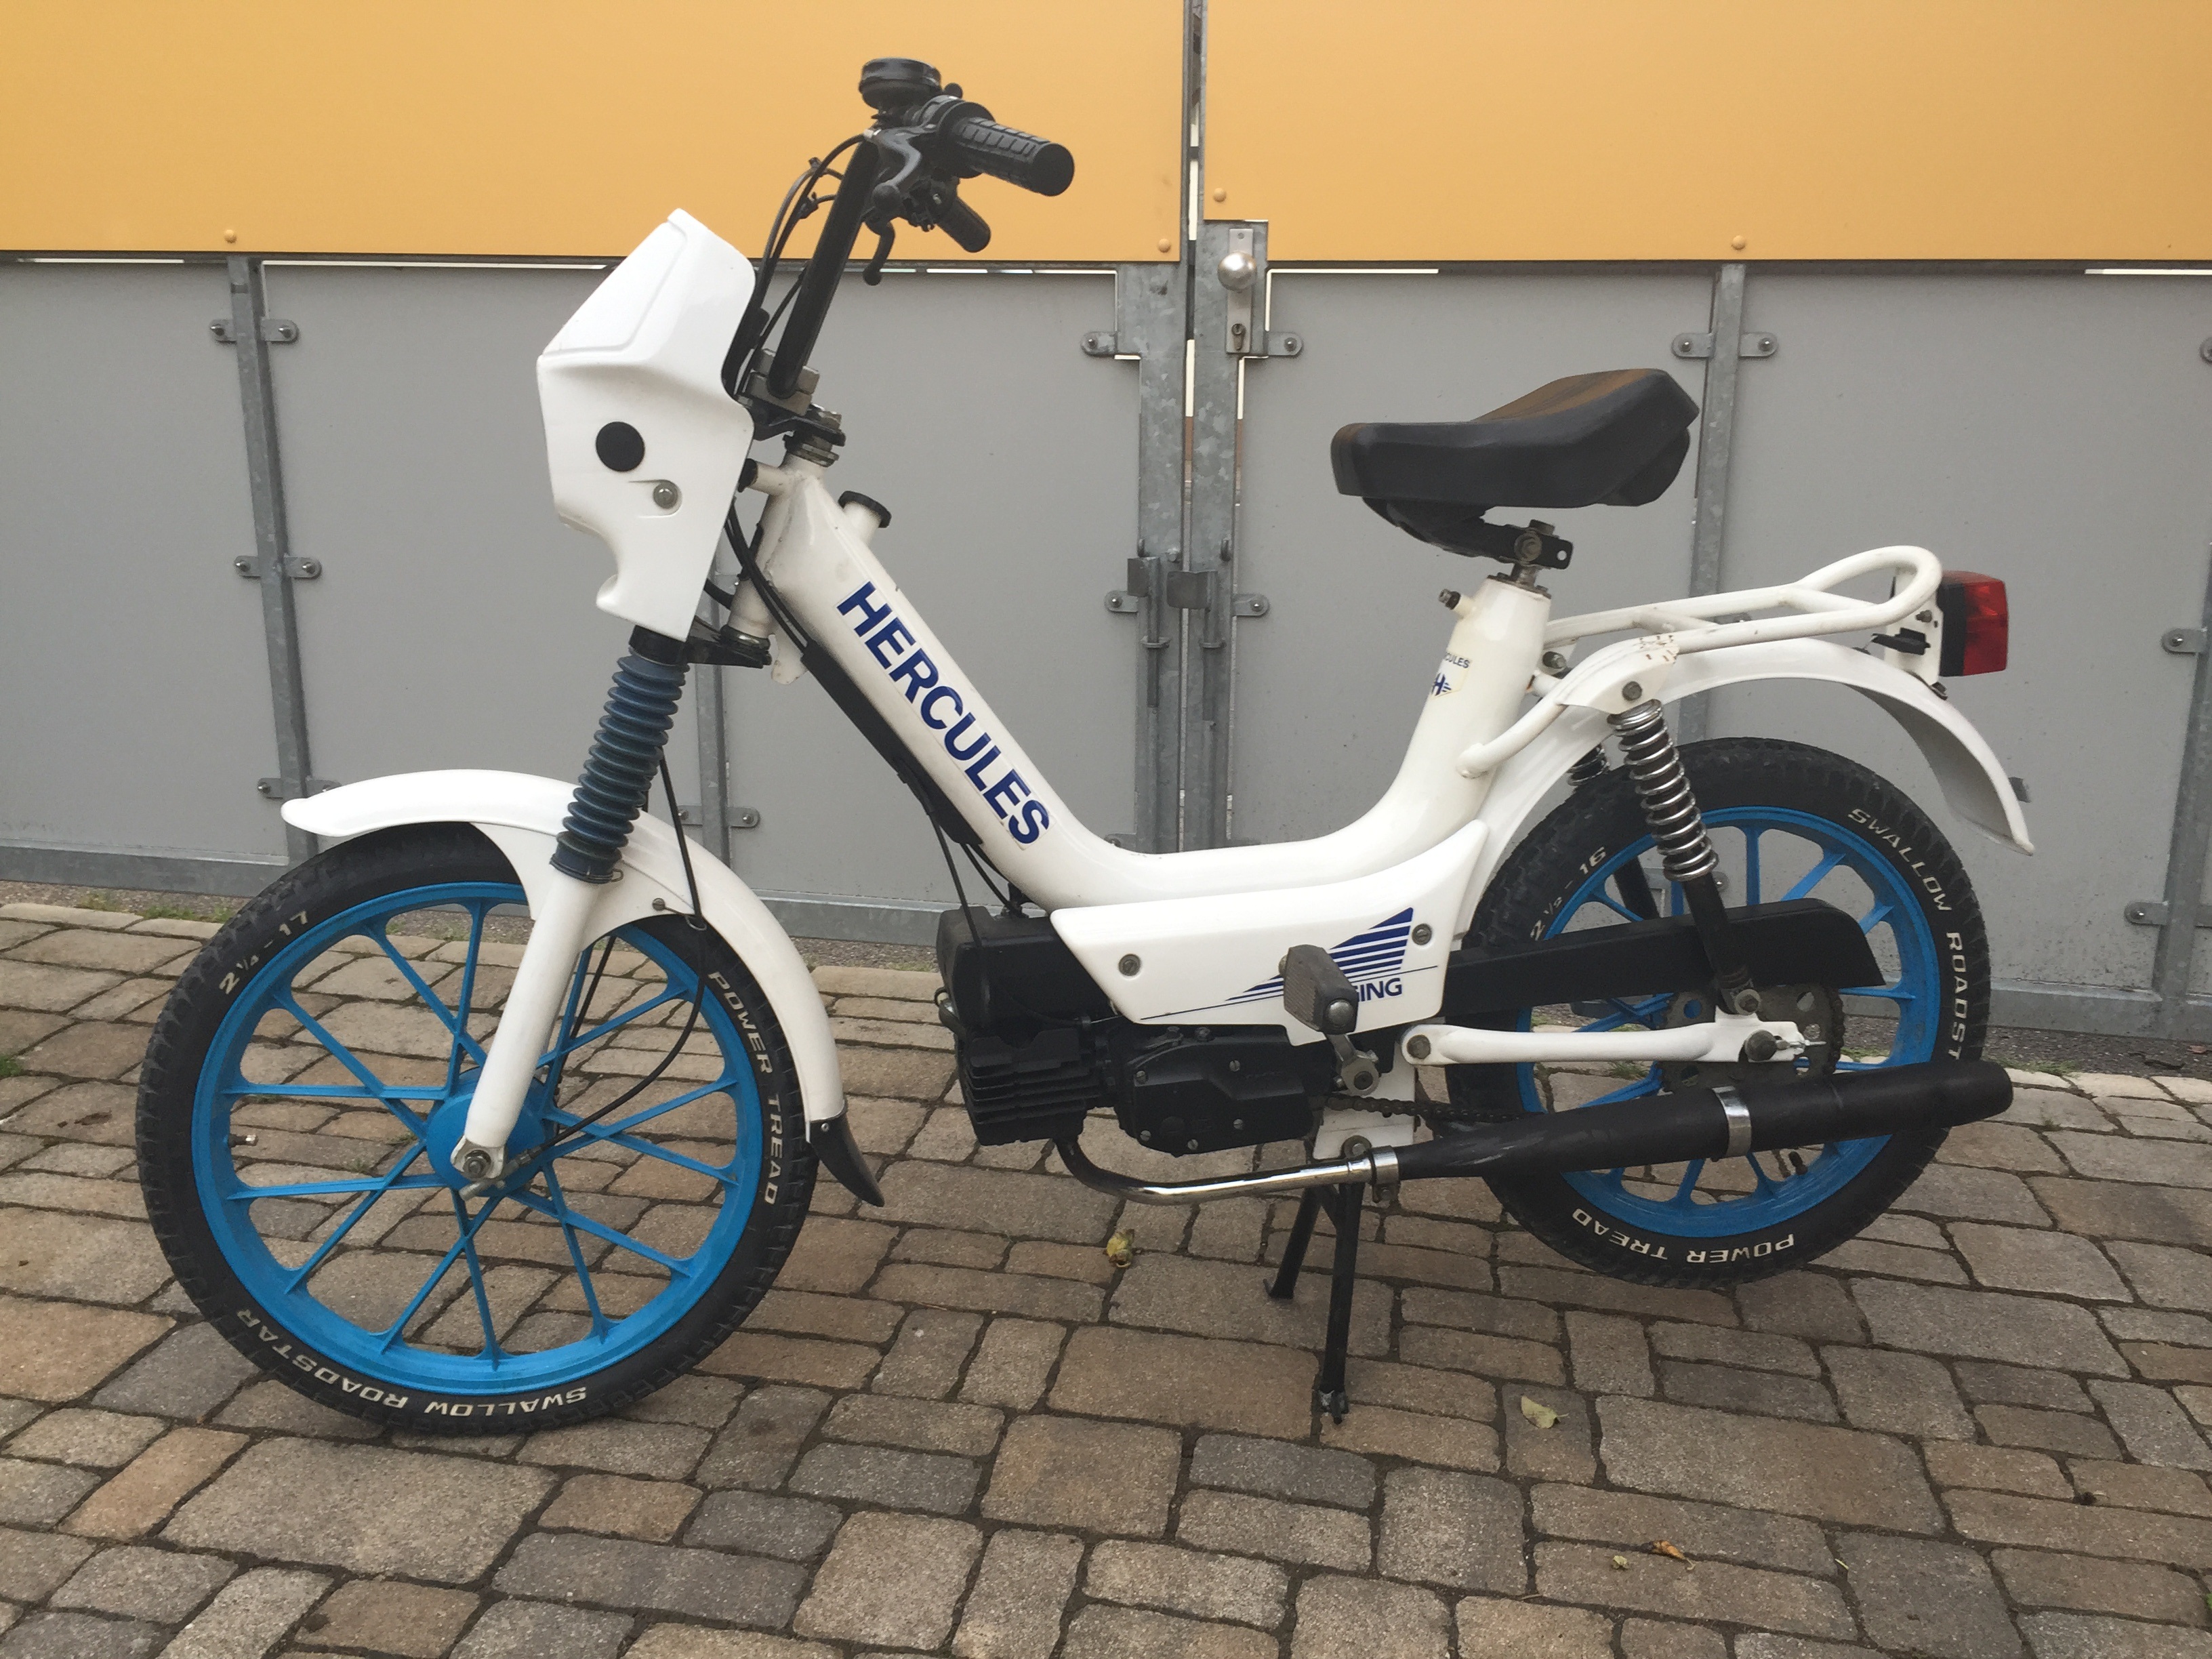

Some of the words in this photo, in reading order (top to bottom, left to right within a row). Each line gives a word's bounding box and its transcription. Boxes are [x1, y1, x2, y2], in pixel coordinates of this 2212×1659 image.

[836, 581, 1050, 844] HERCULES
[1847, 808, 1952, 912] SWALLOW
[1353, 977, 1403, 1002] ING
[708, 971, 773, 1074] POWER
[764, 1094, 783, 1205] TREAD
[1572, 1208, 1668, 1261] TREAD
[1686, 1234, 1795, 1263] POWER
[235, 1309, 409, 1410] ROADSTAR
[424, 1386, 587, 1417] SWALLOW
